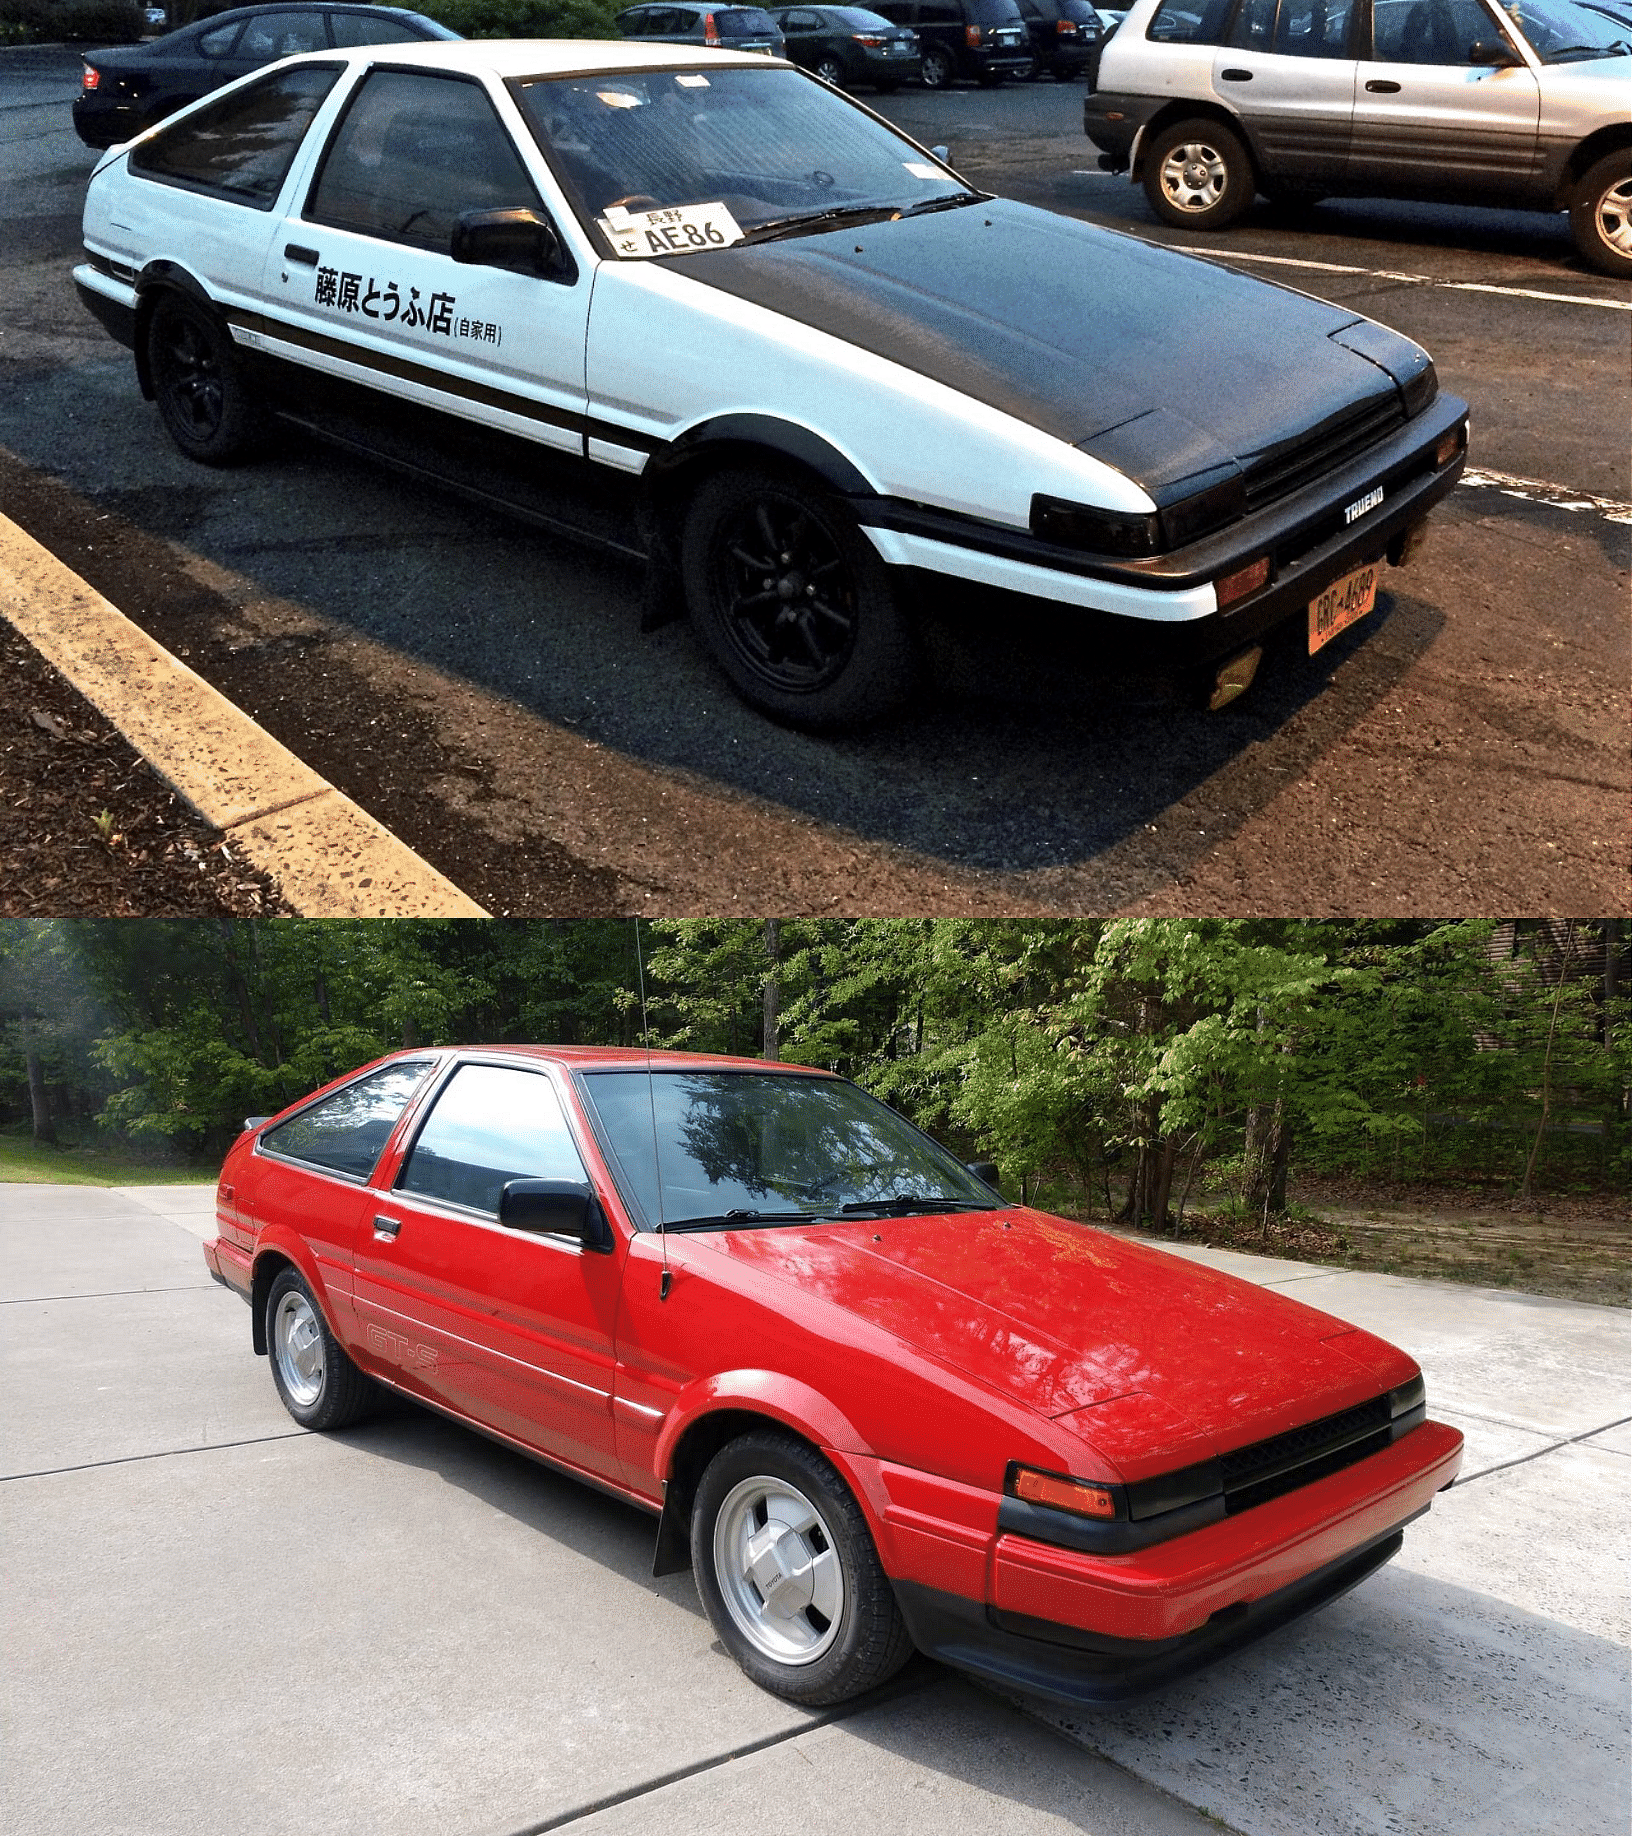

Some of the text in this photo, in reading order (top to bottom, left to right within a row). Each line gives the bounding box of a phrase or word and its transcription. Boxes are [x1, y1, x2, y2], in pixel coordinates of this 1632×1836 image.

[646, 209, 682, 225] 長野
[620, 240, 638, 253] せ
[644, 221, 725, 253] AE86
[315, 265, 456, 336] 藤原とうふ店
[1344, 485, 1384, 524] TRUENO
[765, 1572, 783, 1590] TOYOTA
